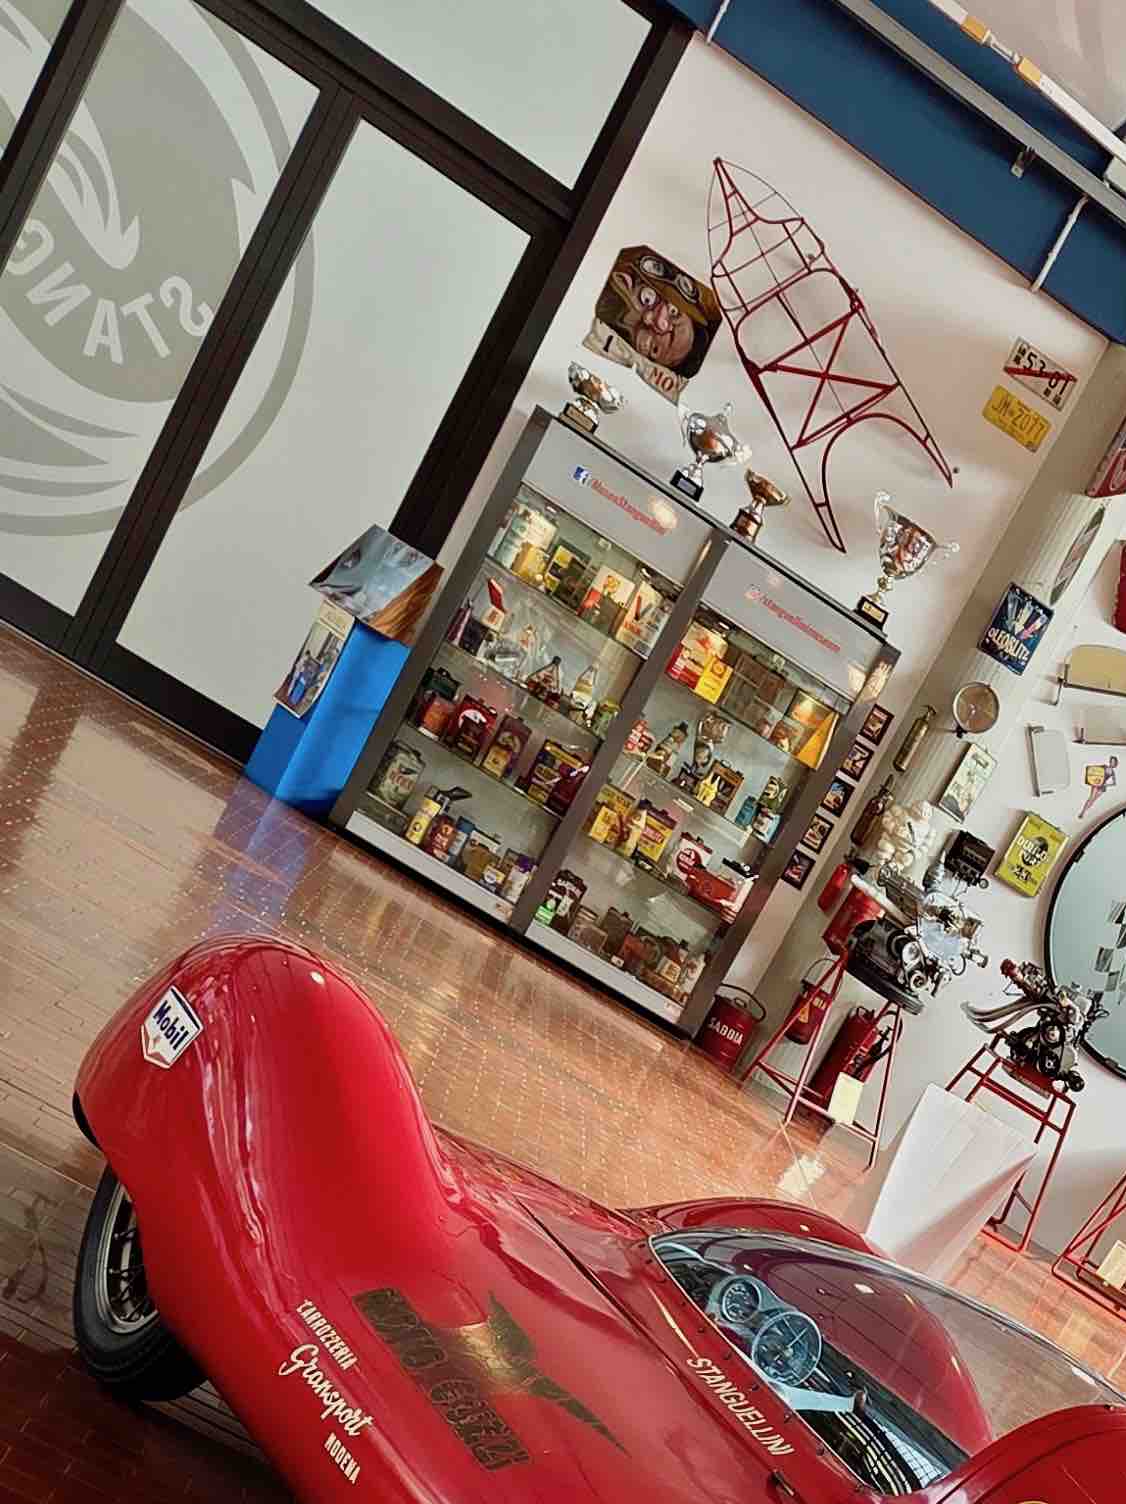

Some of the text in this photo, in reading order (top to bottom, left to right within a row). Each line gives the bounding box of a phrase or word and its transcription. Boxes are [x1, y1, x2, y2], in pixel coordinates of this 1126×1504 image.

[153, 1000, 190, 1051] Mobil
[296, 1299, 358, 1371] CARROZZERIA
[278, 1344, 374, 1437] Gransport
[686, 1357, 795, 1456] STANGUELLINI
[323, 1432, 361, 1485] MODENA
